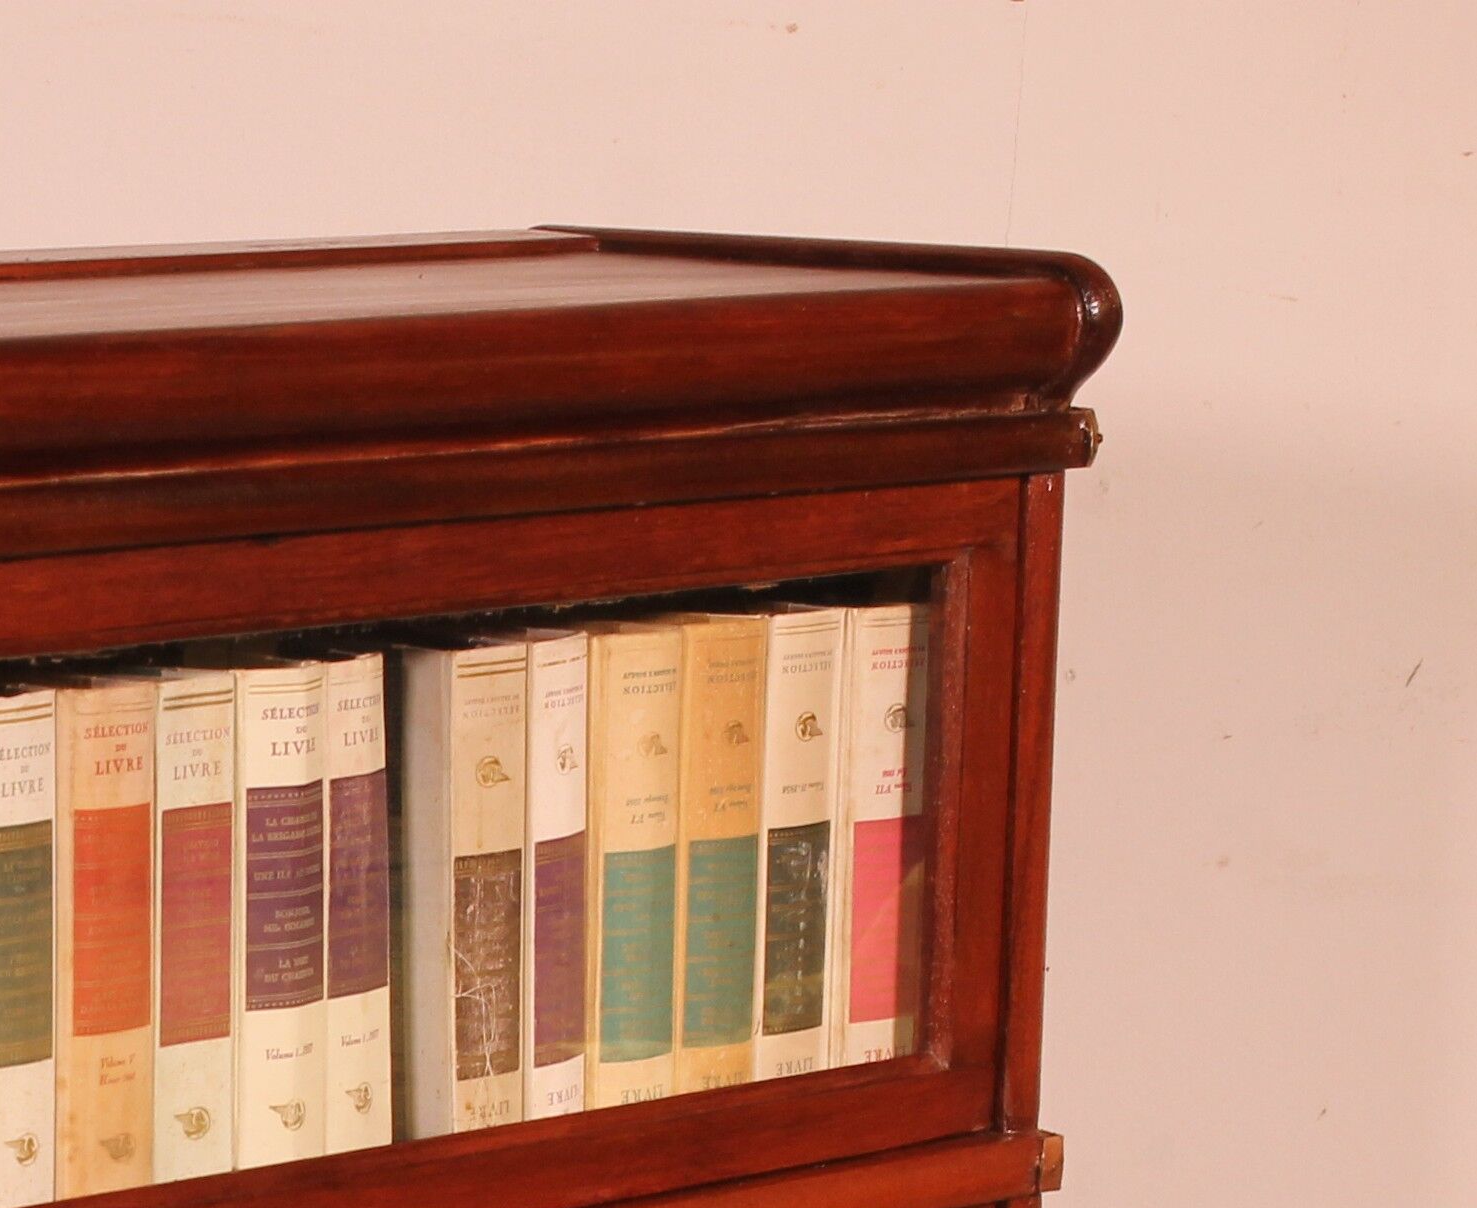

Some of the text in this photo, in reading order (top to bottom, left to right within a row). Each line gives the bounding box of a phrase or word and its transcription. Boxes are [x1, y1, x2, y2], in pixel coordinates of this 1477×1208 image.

[84, 721, 149, 740] SÉLECTION
[95, 756, 144, 776] LIVRE
[173, 761, 222, 781] LIVRE
[1, 777, 45, 798] LIVRE
[776, 1057, 813, 1077] LIVRE
